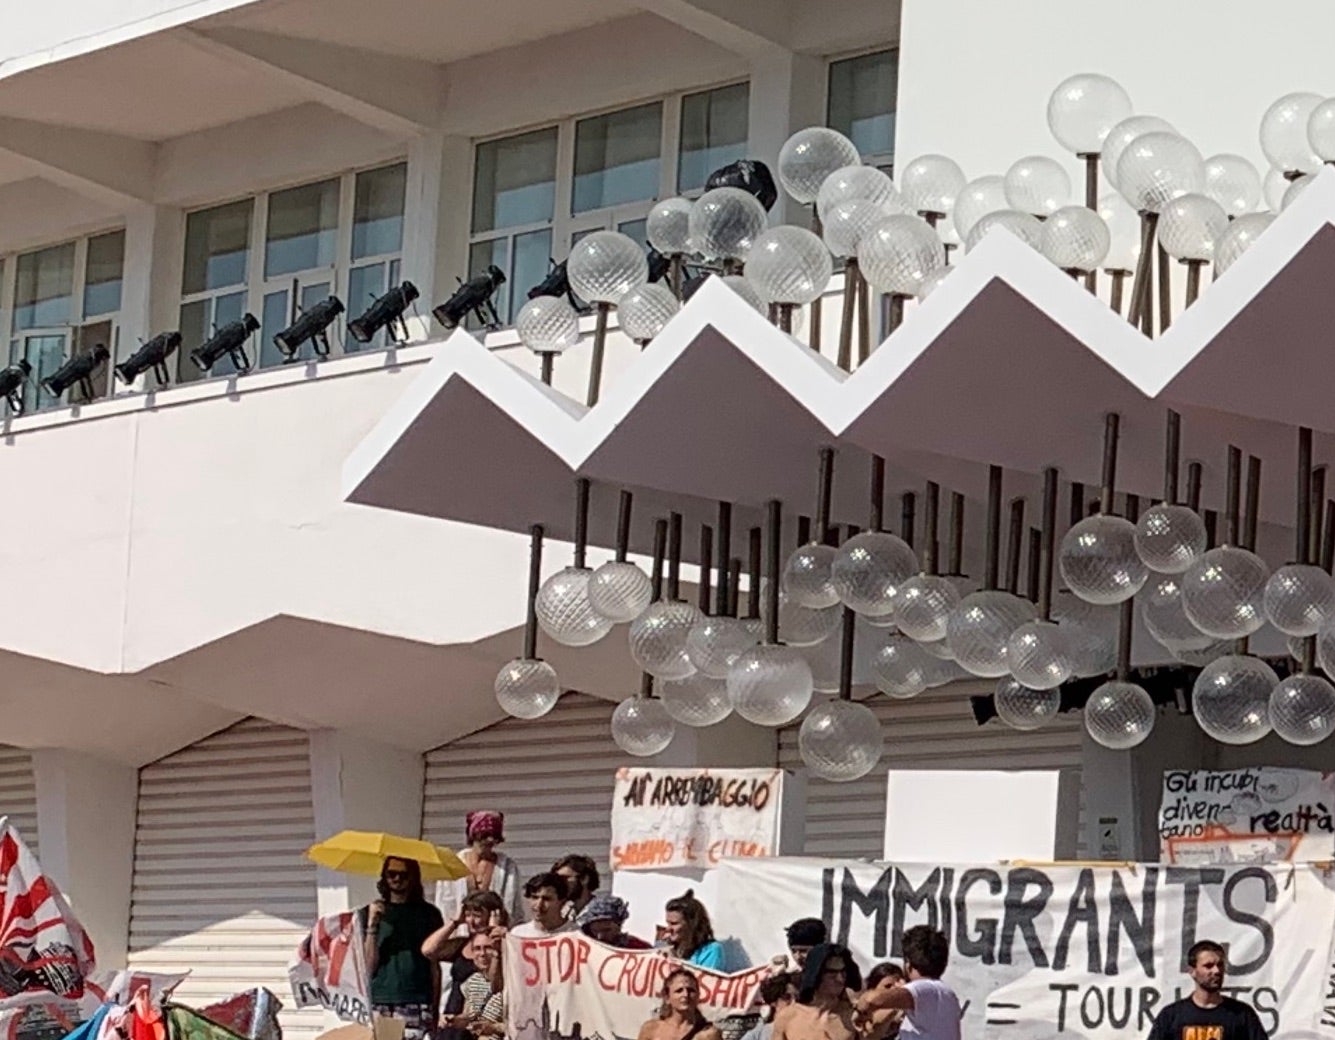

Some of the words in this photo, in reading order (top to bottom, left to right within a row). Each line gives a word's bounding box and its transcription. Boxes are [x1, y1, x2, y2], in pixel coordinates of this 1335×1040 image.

[1167, 771, 1197, 793] Gli
[1204, 768, 1262, 794] incubi
[521, 938, 591, 986] STOP
[598, 952, 690, 998] CRUIS
[698, 967, 771, 1010] SHIP
[1050, 984, 1279, 1035] TOURTS
